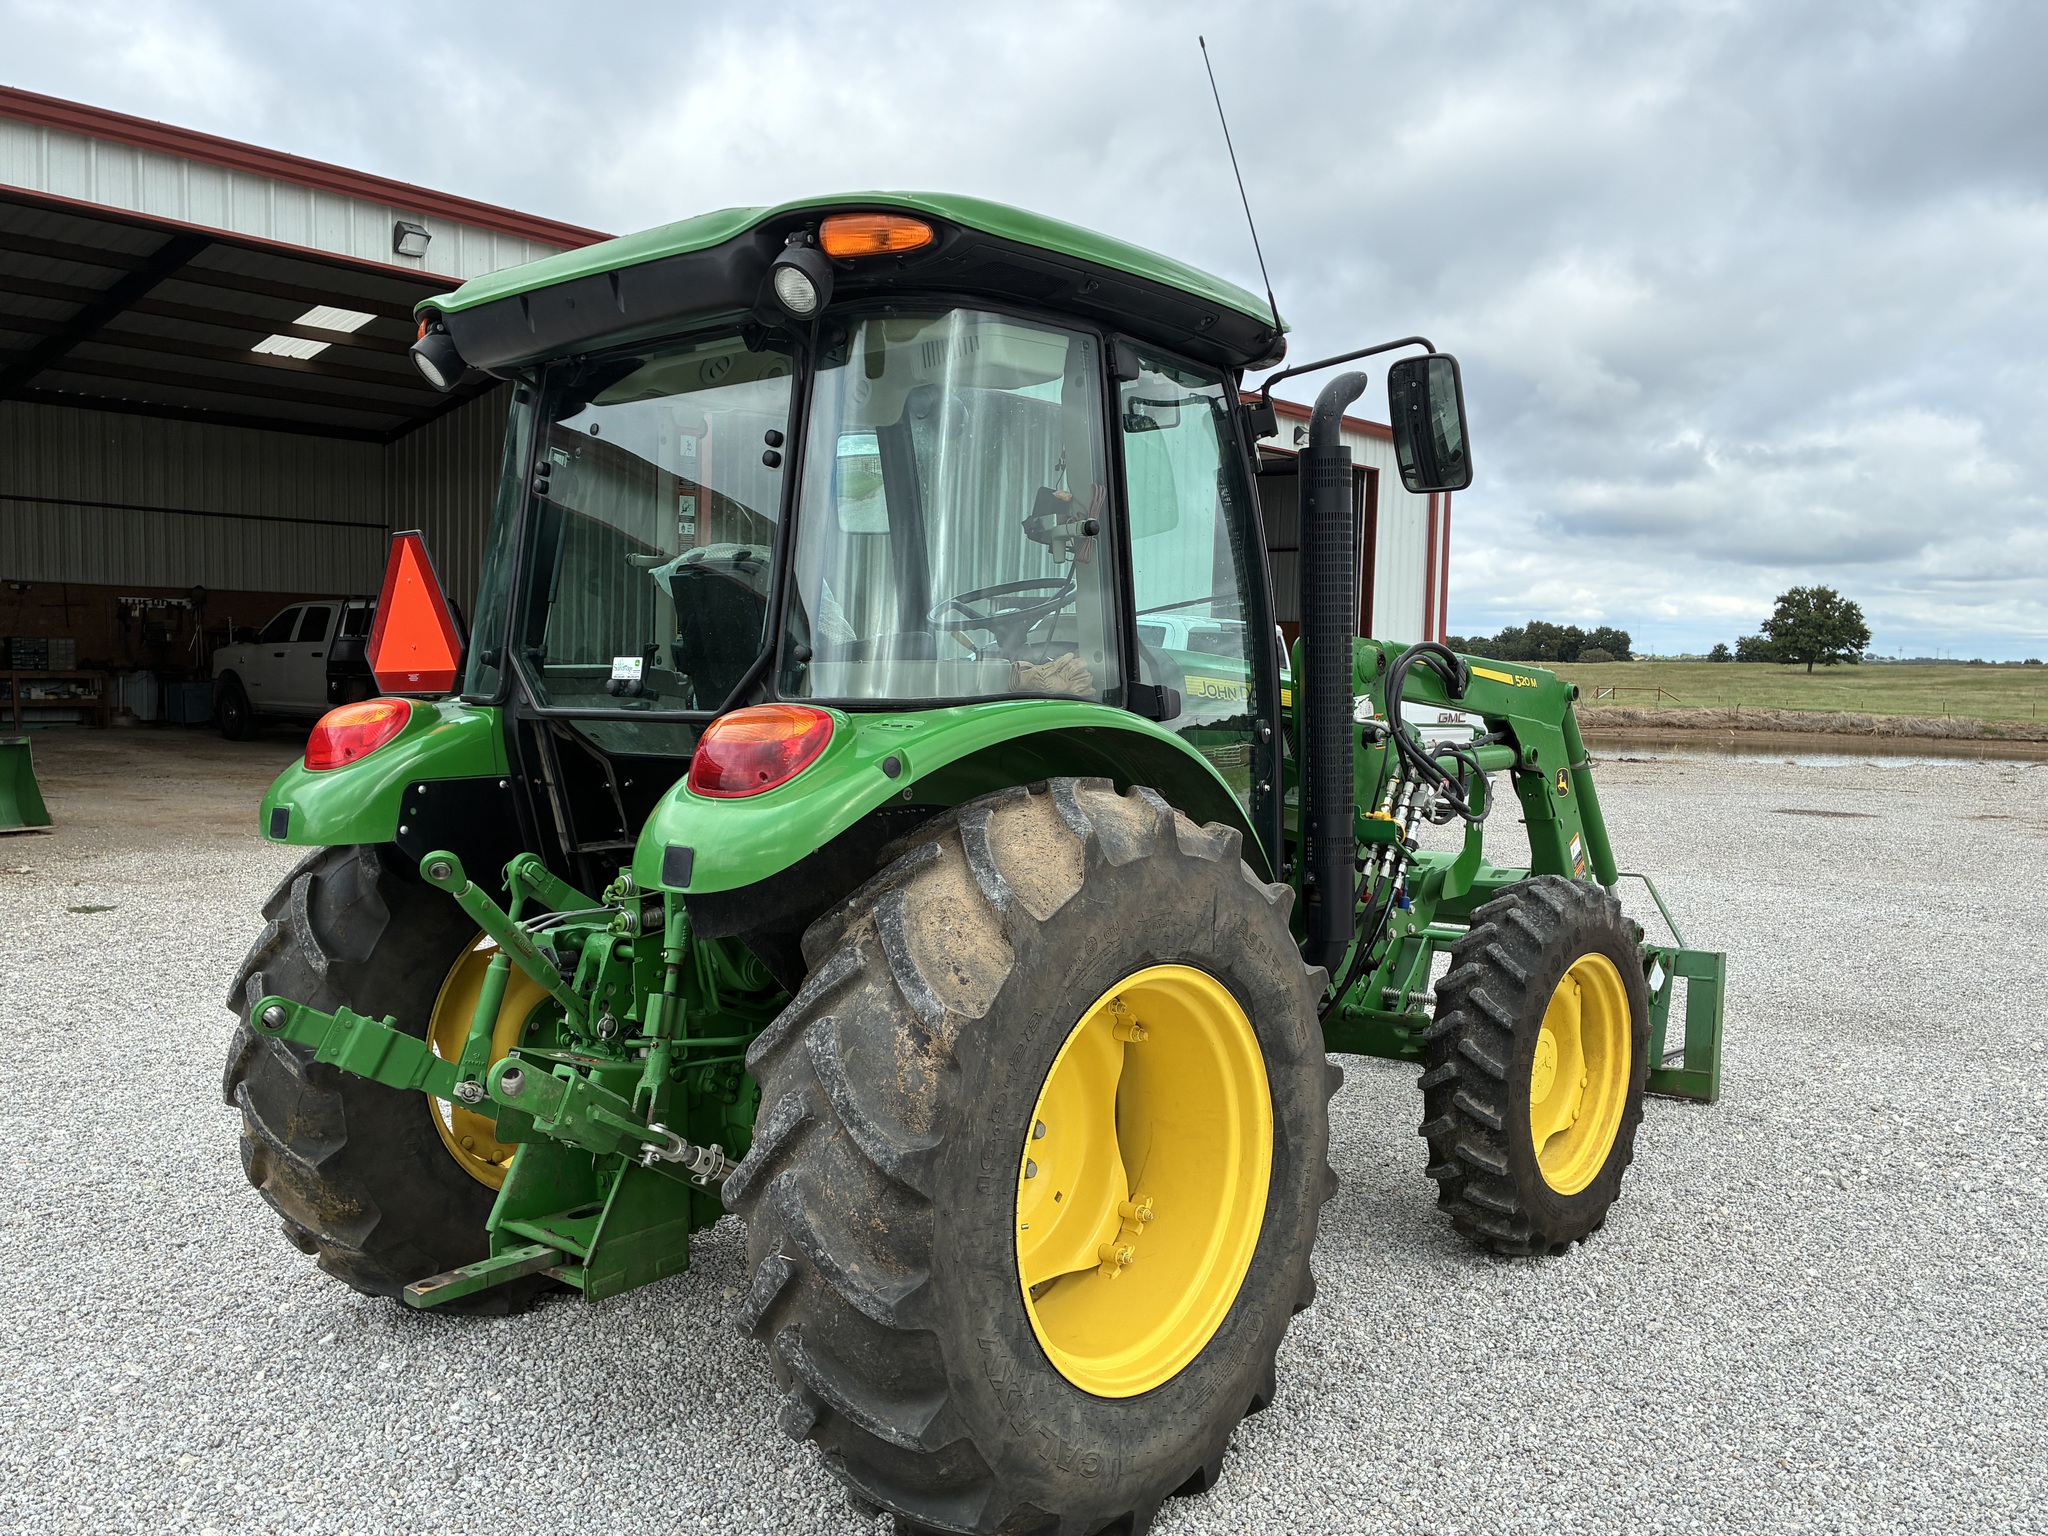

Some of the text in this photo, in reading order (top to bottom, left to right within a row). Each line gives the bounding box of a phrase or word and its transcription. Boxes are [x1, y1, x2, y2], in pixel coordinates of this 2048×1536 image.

[1198, 680, 1237, 700] JOHN
[1438, 712, 1467, 723] GMC
[977, 1336, 1104, 1479] GALAXY
